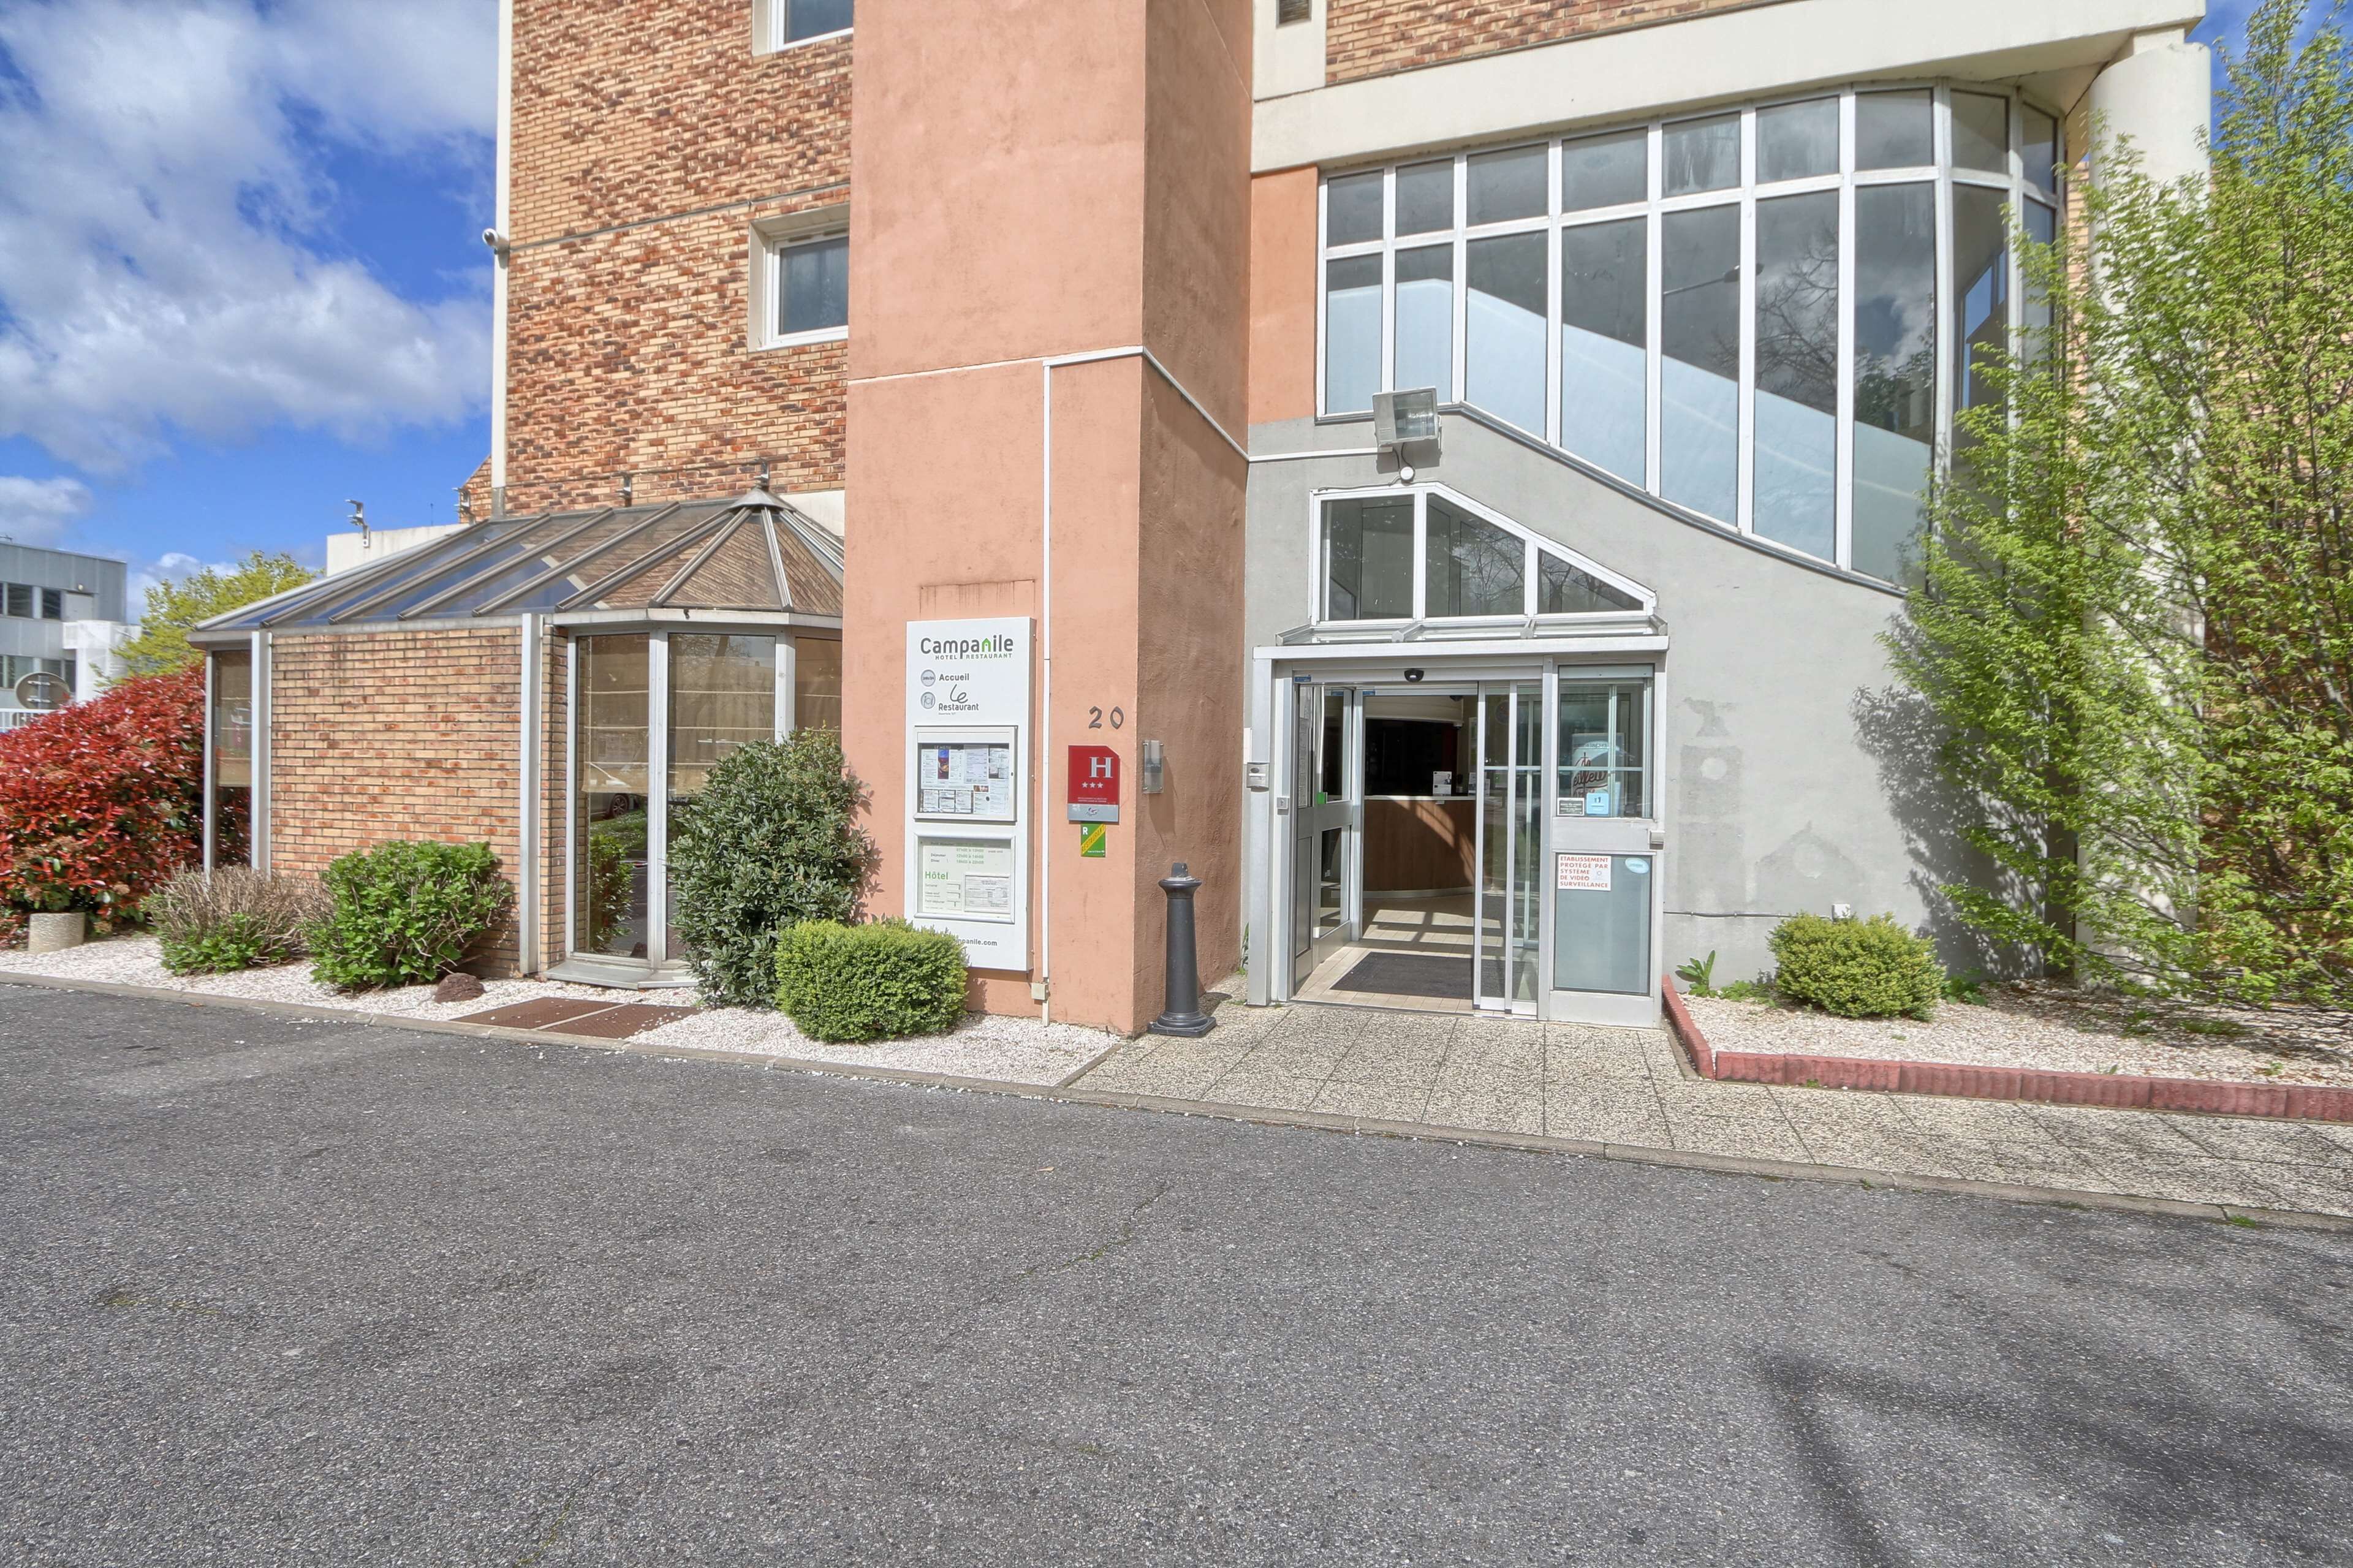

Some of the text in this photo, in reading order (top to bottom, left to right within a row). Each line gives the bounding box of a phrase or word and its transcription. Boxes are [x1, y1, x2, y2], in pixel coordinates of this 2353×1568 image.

[920, 634, 1014, 659] Campanile
[939, 673, 969, 681] Accueil
[950, 684, 968, 703] Le
[938, 703, 979, 711] Restaurant
[1088, 706, 1124, 730] 20
[1089, 756, 1113, 778] H
[1082, 827, 1088, 835] R
[925, 871, 949, 880] Hôtel
[956, 938, 998, 947] mpanile.com
